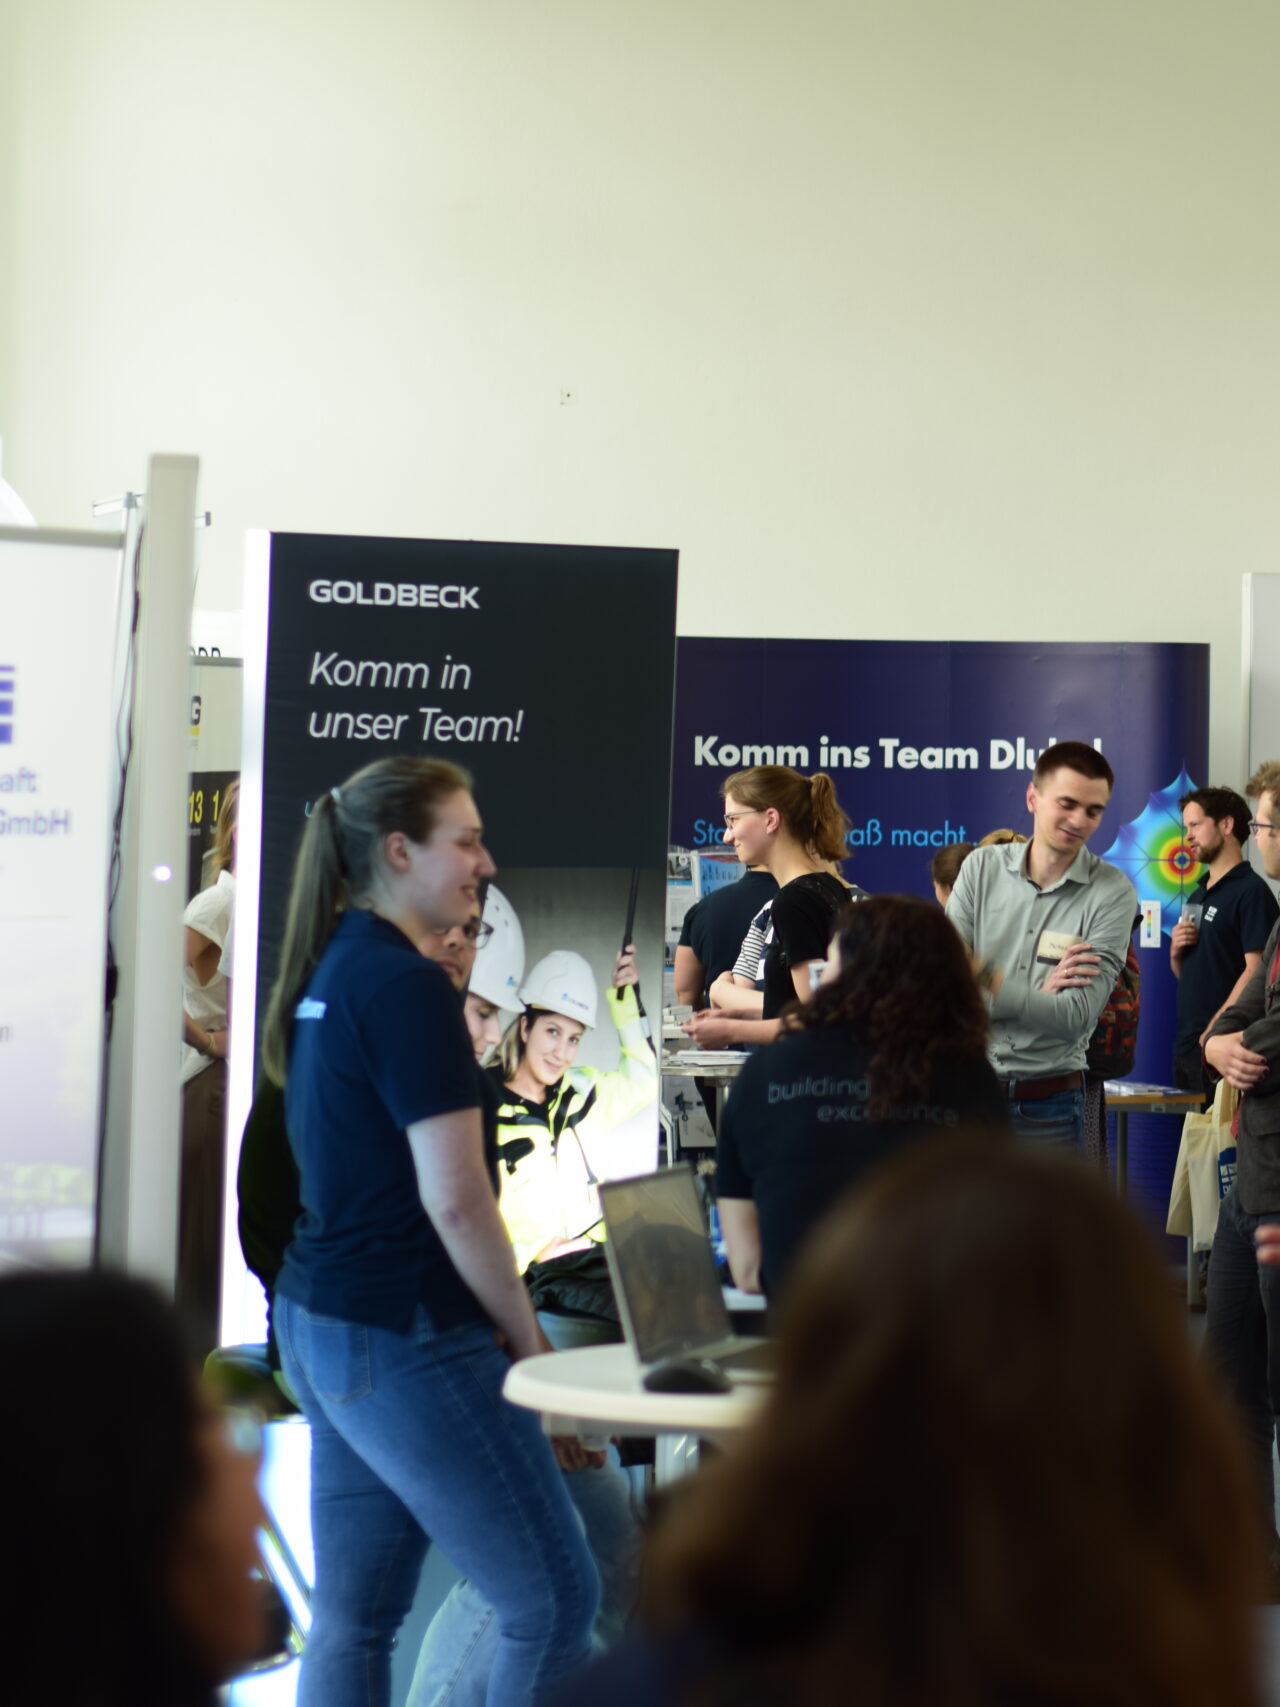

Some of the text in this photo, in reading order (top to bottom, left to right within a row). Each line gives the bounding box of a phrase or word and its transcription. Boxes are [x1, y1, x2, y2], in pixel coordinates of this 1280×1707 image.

[309, 579, 480, 609] GOLDBECK
[309, 651, 471, 690] Komm in
[308, 707, 524, 742] unser Team!
[693, 735, 809, 767] Komm
[820, 735, 871, 768] ins
[879, 738, 979, 769] Team
[768, 1074, 871, 1104] building
